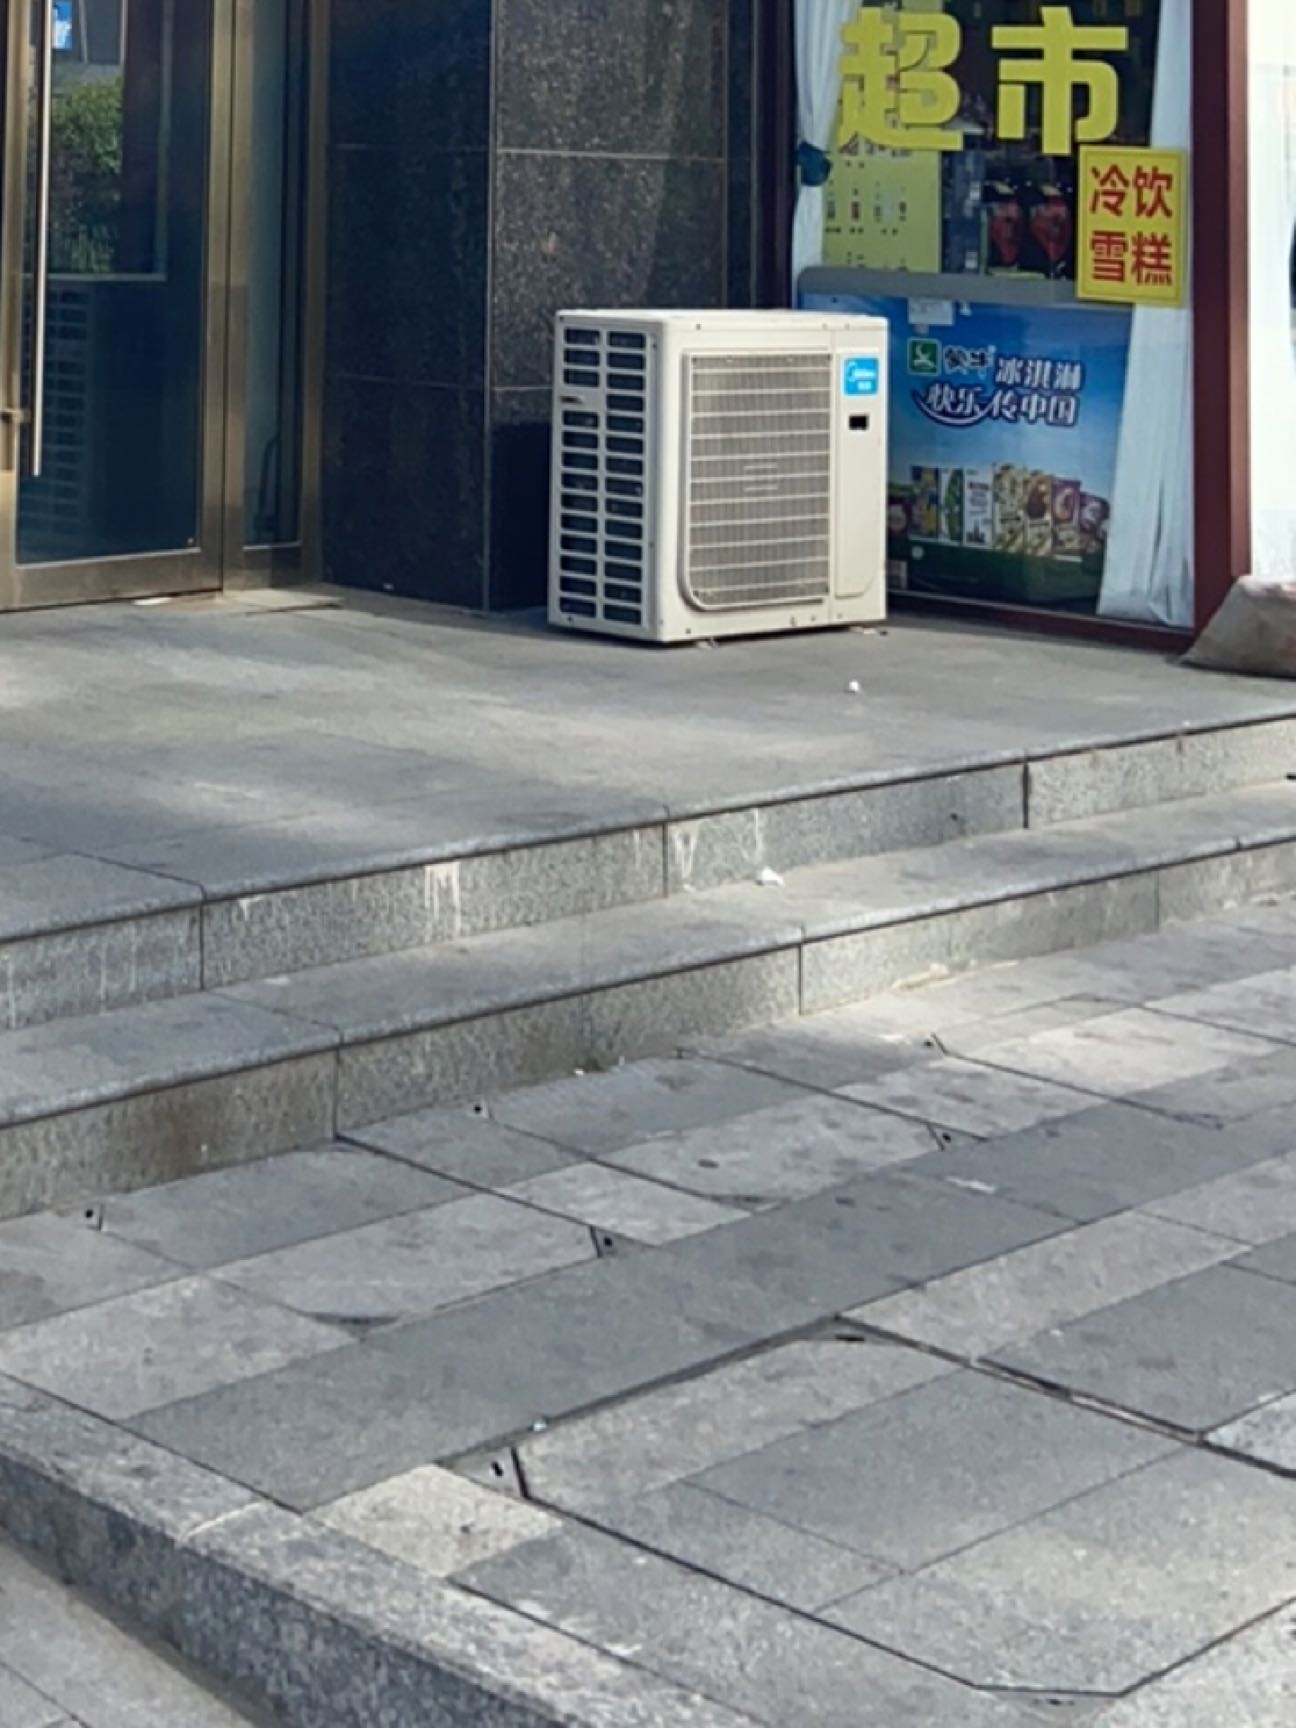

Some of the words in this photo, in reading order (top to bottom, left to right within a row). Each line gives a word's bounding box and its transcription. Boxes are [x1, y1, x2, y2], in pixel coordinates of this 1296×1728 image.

[834, 6, 1130, 156] 超市
[1090, 164, 1173, 218] 冷饮
[1090, 230, 1173, 286] 雪糕
[995, 357, 1082, 390] 冰淇淋
